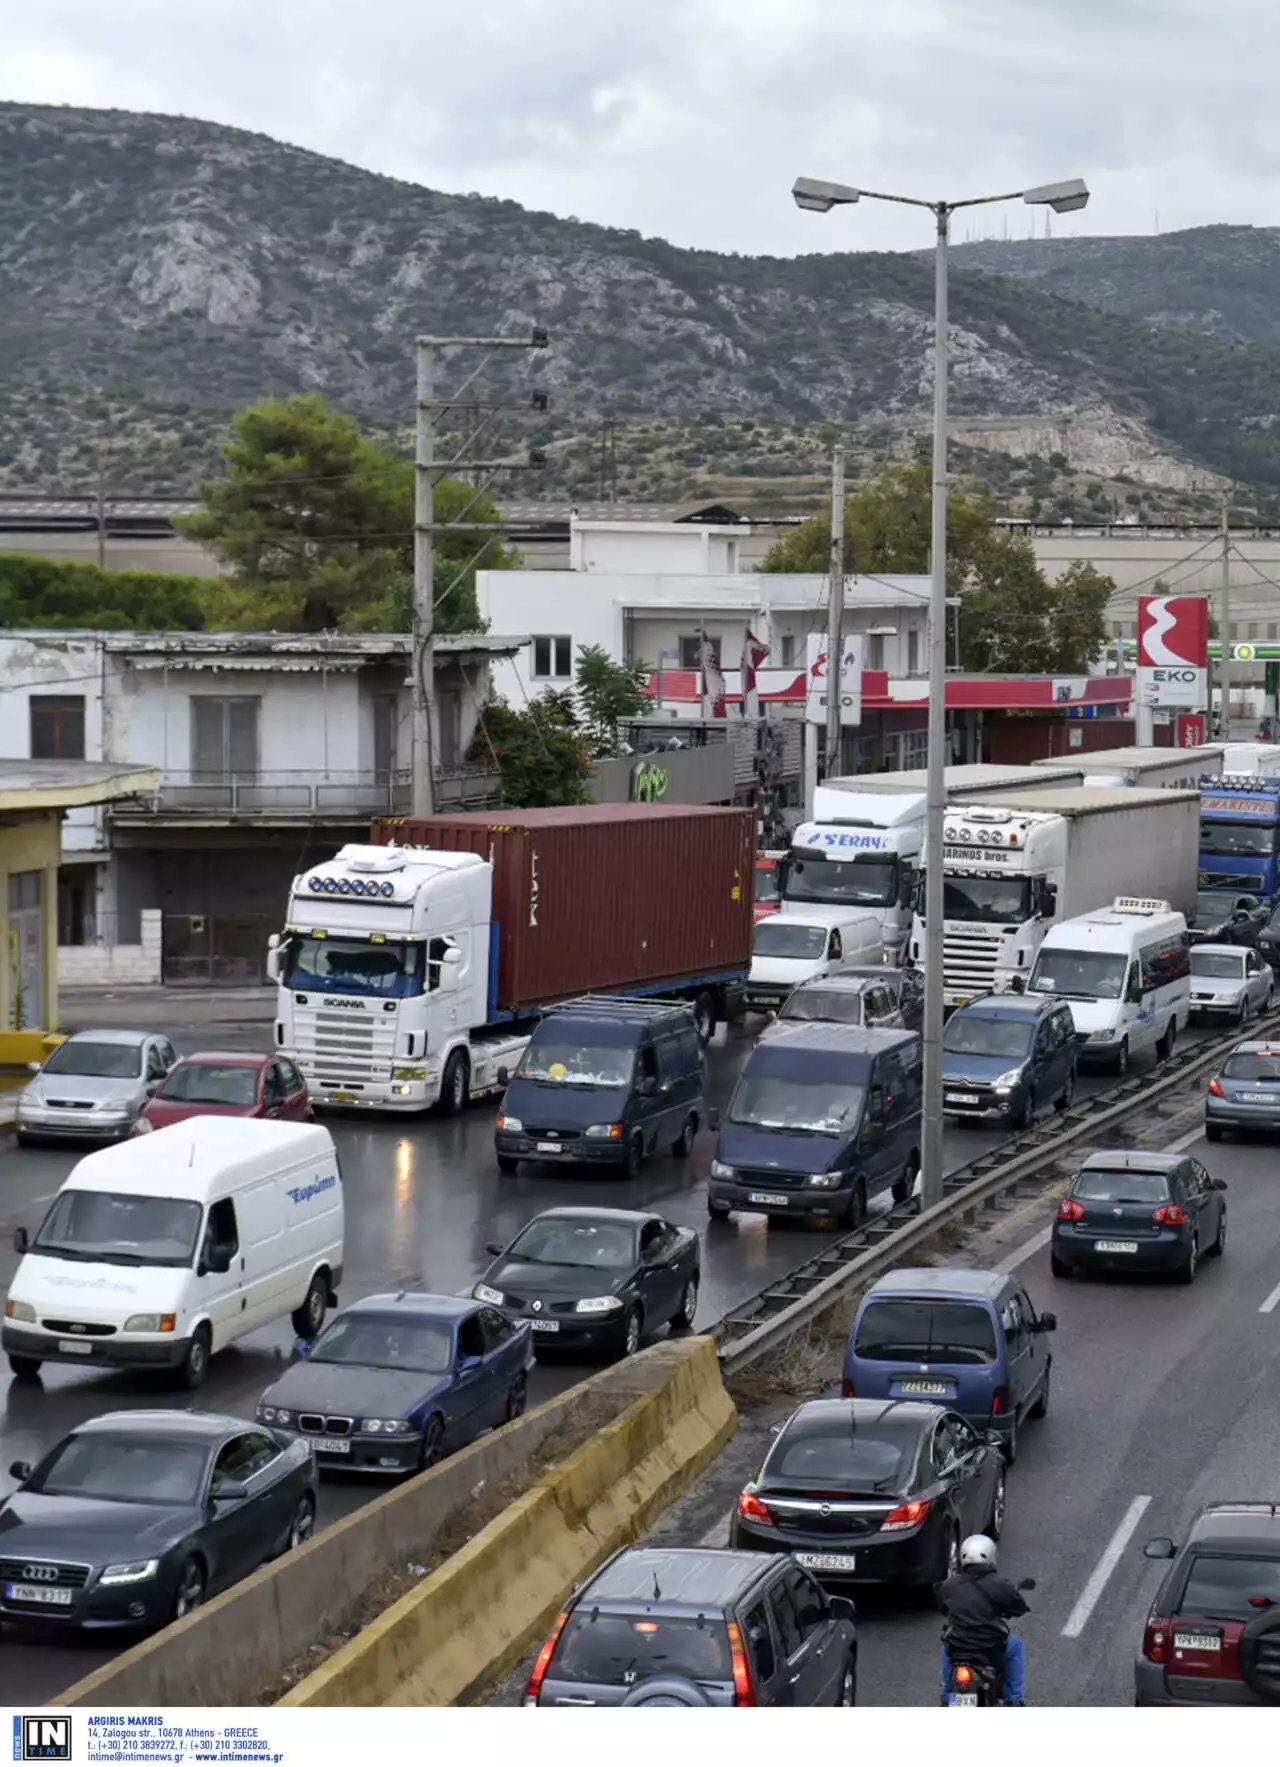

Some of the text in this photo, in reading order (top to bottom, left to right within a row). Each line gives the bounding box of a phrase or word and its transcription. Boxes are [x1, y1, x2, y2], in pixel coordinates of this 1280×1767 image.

[1153, 670, 1196, 682] EKO
[819, 696, 853, 706] EO
[323, 998, 366, 1009] SCANIA
